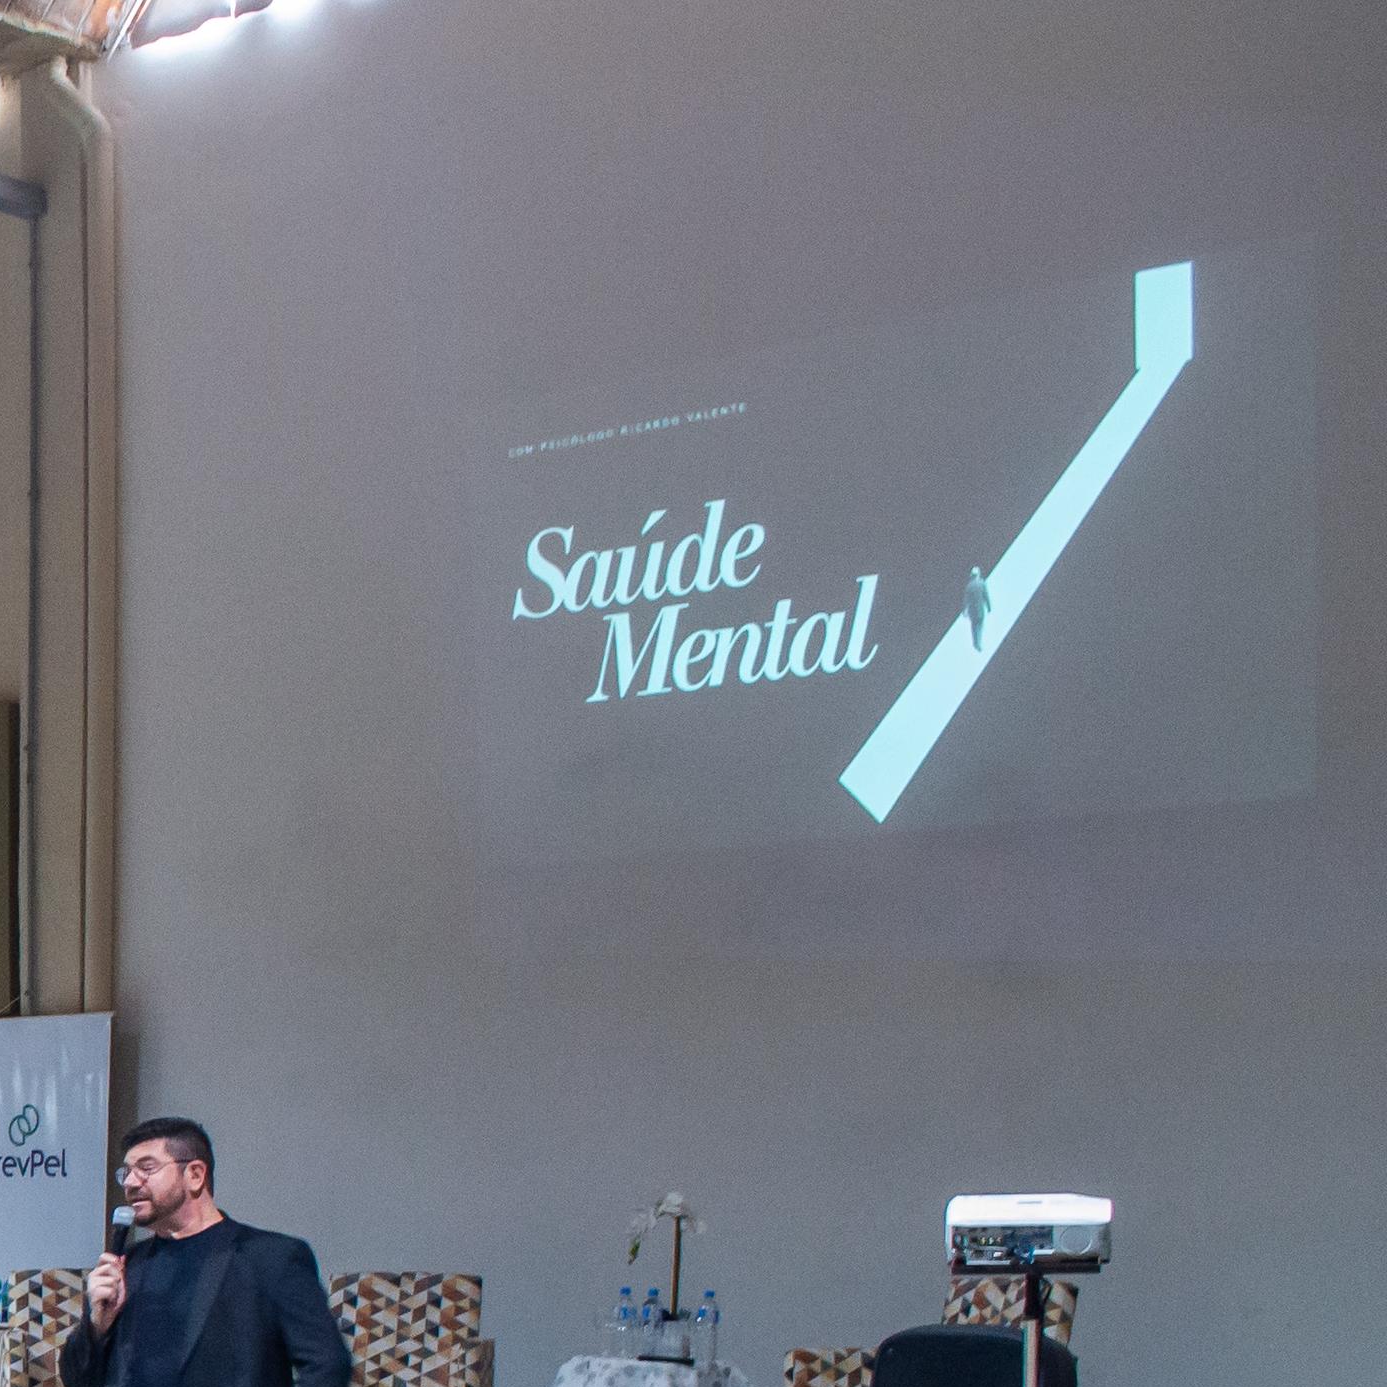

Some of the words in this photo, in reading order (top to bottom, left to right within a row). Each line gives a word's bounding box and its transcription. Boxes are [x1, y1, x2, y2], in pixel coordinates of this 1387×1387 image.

[508, 444, 533, 458] COM
[619, 415, 680, 435] RICARDO
[687, 402, 747, 422] VALENTE
[512, 499, 766, 621] Saúde
[585, 574, 879, 703] Mental
